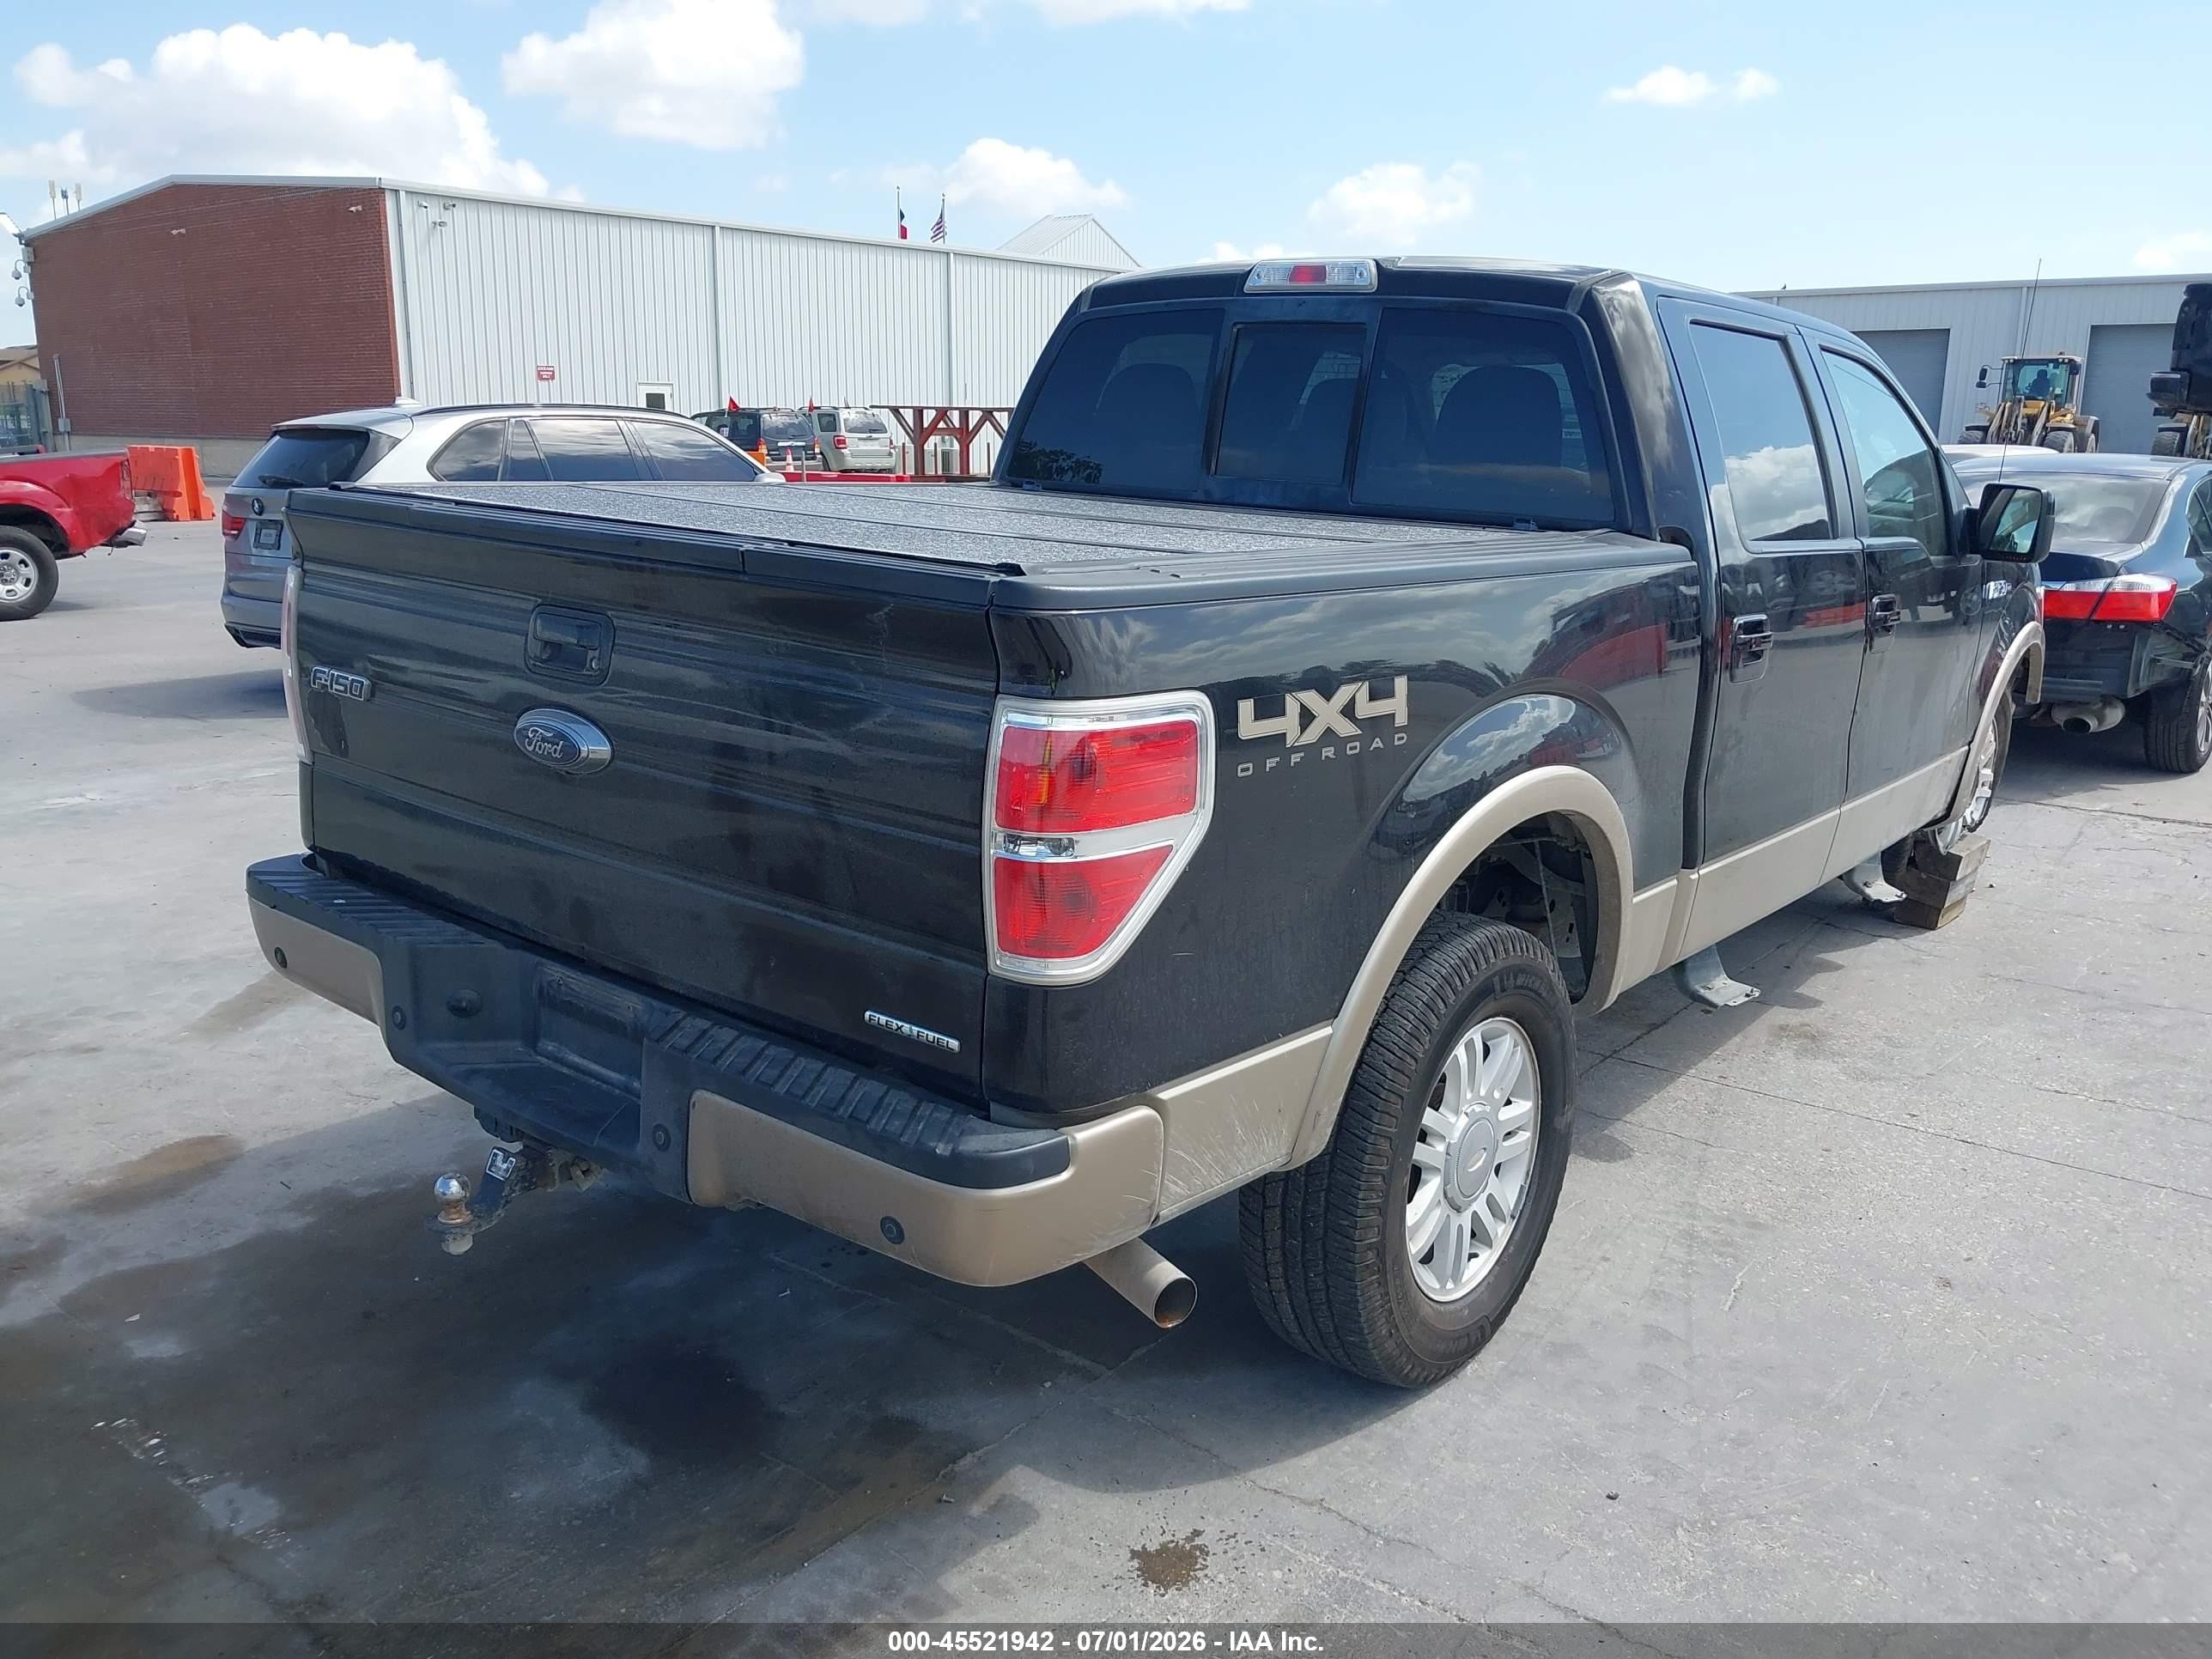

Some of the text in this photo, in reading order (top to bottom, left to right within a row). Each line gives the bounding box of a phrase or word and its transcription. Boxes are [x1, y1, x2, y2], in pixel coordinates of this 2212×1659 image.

[525, 726, 564, 758] Ford
[868, 1014, 955, 1051] FLEX FUEL
